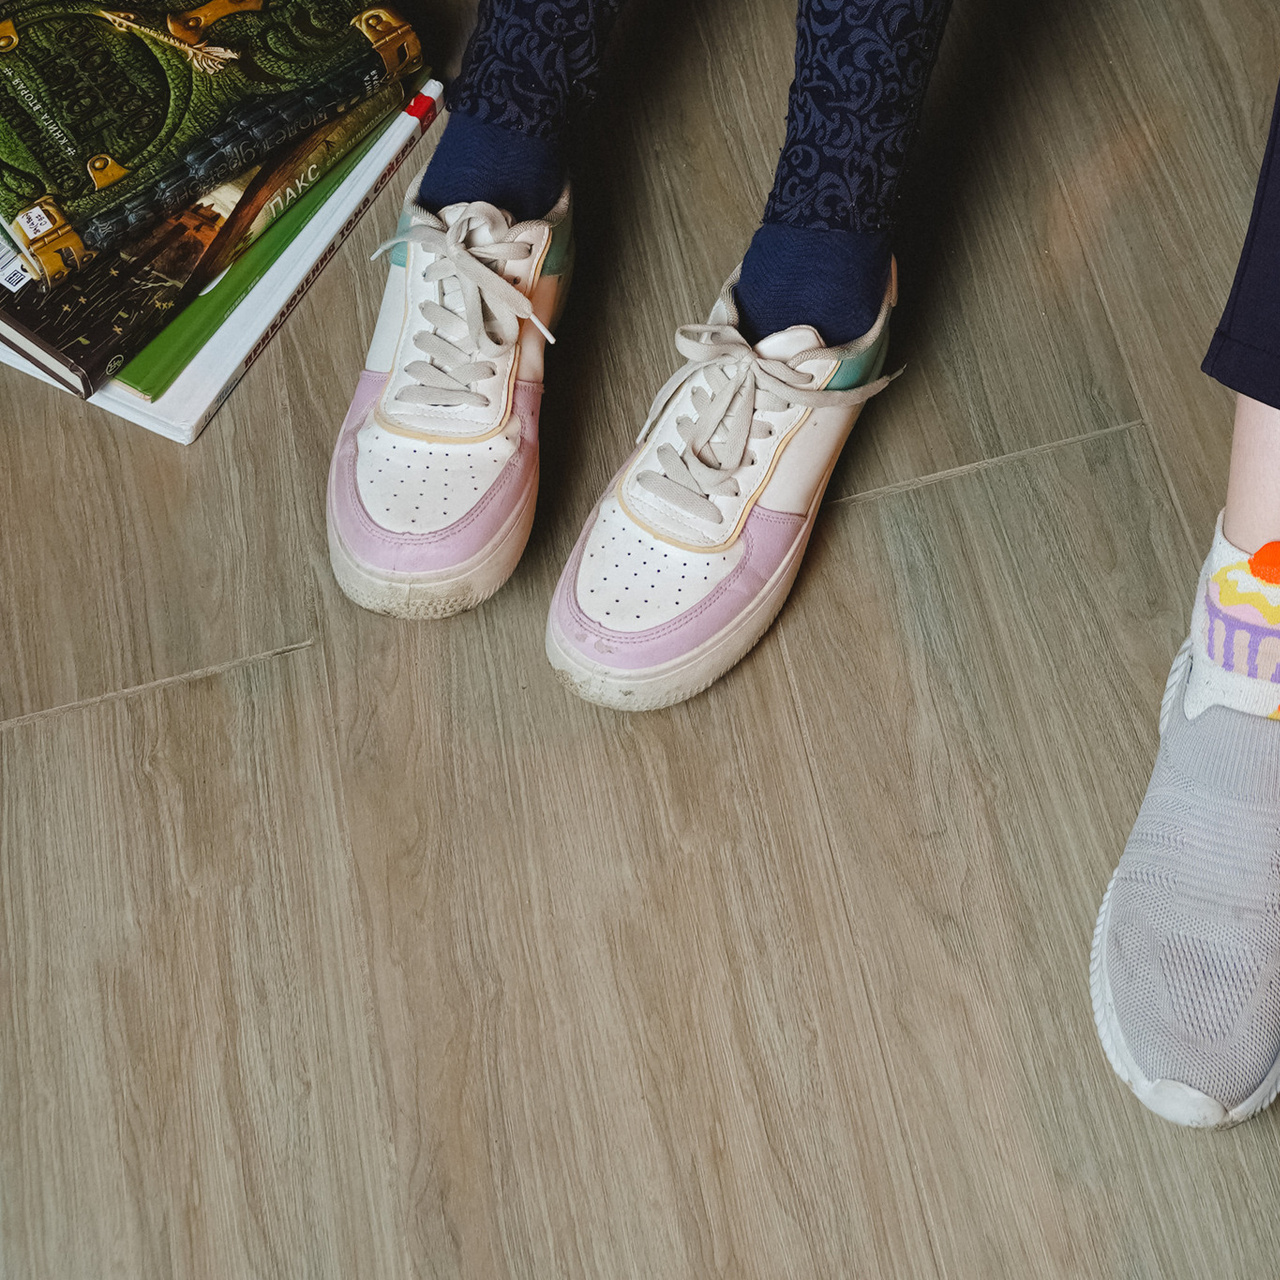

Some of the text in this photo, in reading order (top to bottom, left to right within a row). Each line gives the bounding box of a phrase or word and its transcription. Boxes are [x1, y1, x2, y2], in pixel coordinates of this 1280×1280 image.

[10, 75, 69, 146] КНИГА ВТОРАЯ
[264, 161, 320, 218] ПАКС
[244, 240, 335, 370] ПРИКЛЮЧЕНИЯ
